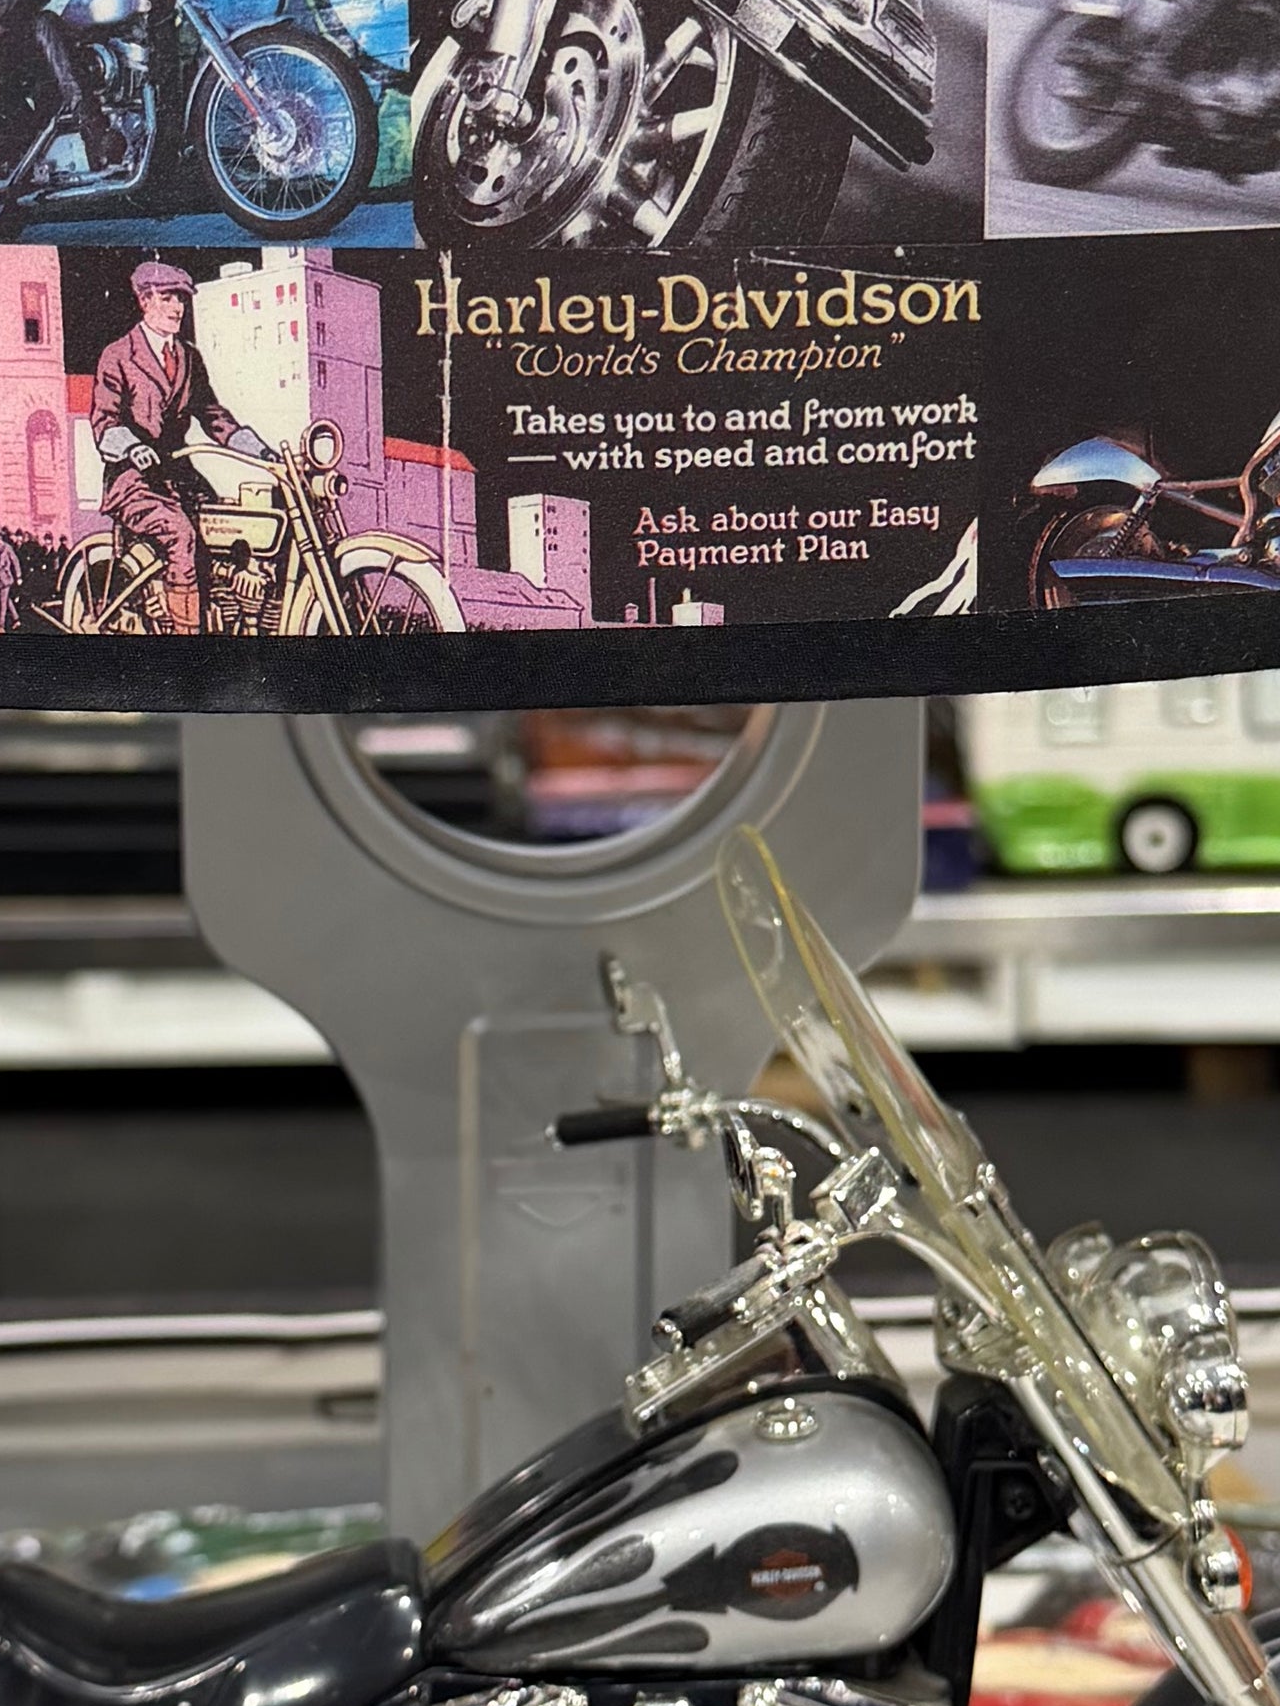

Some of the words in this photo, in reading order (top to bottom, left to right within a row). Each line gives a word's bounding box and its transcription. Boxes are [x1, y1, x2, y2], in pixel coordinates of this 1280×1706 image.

[414, 268, 982, 342] Harley-Davidson
[506, 404, 606, 436] Takes
[614, 412, 674, 440] you
[681, 406, 717, 433] to
[724, 399, 792, 431] and
[803, 397, 886, 436] from
[890, 394, 979, 425] work
[654, 438, 756, 475] speed
[764, 434, 830, 467] and
[836, 430, 977, 469] comfort
[632, 505, 701, 536] Ask
[710, 503, 800, 532] about
[807, 506, 862, 531] our
[867, 497, 941, 532] Easy
[636, 535, 789, 573] Payment
[795, 534, 871, 563] Plan
